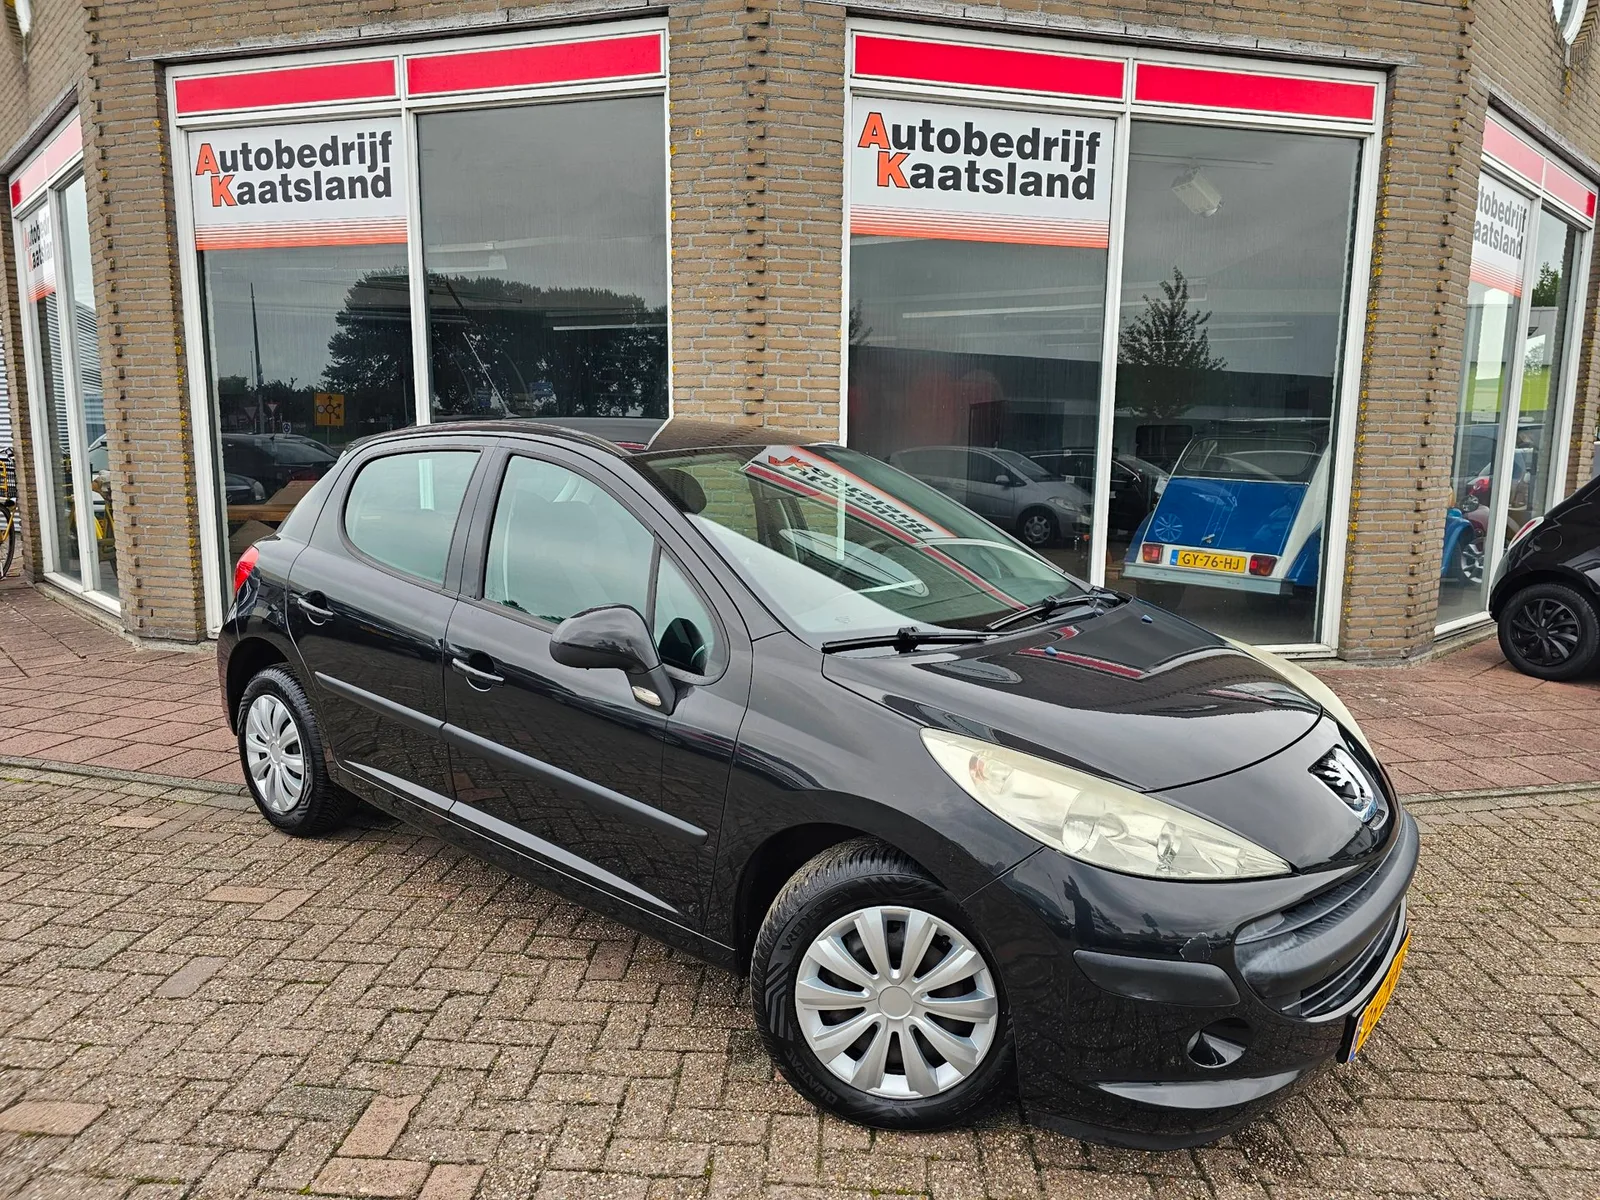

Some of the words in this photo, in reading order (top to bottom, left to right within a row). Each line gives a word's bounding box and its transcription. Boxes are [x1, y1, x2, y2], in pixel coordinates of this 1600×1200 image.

[195, 130, 392, 175] Autobedrijf
[857, 111, 1101, 172] Autobedrijf
[210, 166, 392, 207] Kaatsland
[877, 151, 1096, 200] Kaatsland
[1181, 552, 1240, 570] GY-76-HJ
